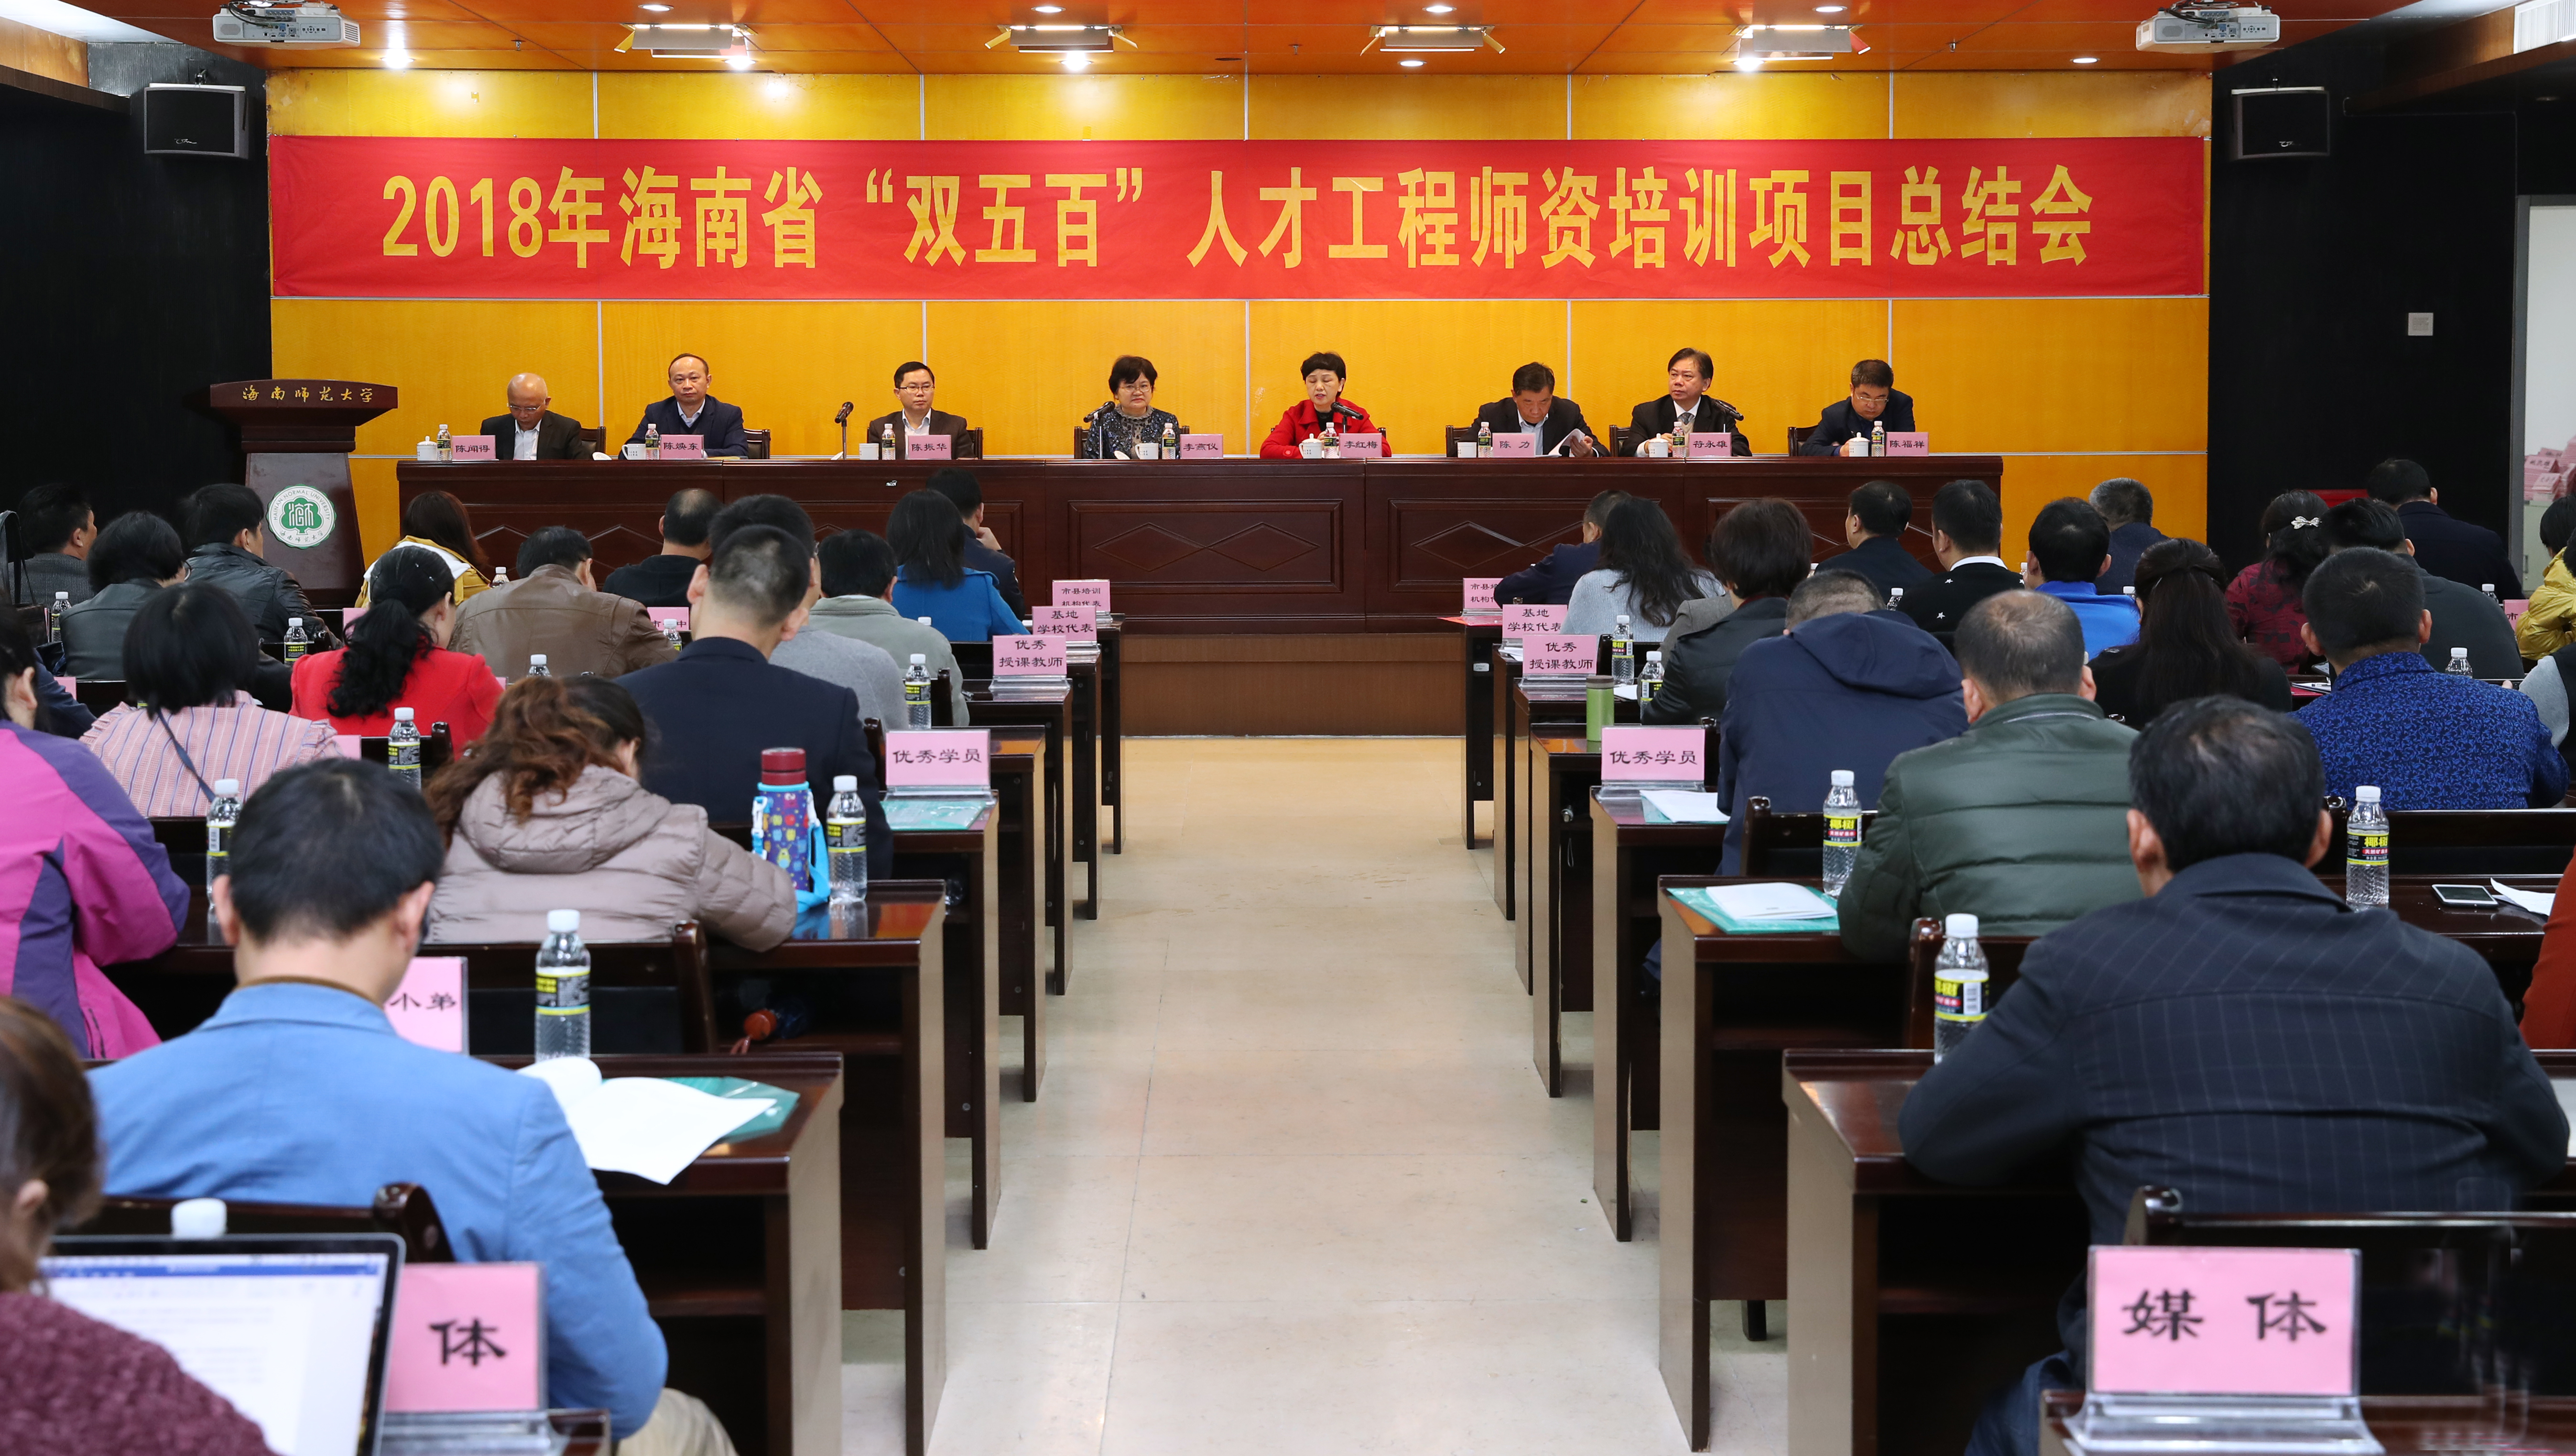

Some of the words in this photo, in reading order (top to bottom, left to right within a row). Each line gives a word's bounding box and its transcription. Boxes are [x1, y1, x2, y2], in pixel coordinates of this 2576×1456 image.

[911, 443, 947, 451] 陈振华
[1183, 443, 1218, 451] 李燕仪
[1890, 440, 1925, 449] 陈福祥
[273, 498, 283, 520] HAINAN
[283, 490, 308, 499] NORMAL
[311, 492, 330, 520] UNIVERSITY
[1051, 610, 1079, 619] 基地
[1522, 608, 1550, 617] 基地
[1037, 623, 1094, 634] 学校代表
[1507, 622, 1562, 632] 学校代表
[1015, 640, 1047, 650] 优秀
[1545, 642, 1577, 653] 优秀
[999, 657, 1063, 668] 授课教师
[1529, 659, 1594, 670] 授课教师
[892, 748, 982, 764] 优秀学员
[1609, 750, 1697, 765] 优秀学员
[1829, 819, 1854, 830] 椰树
[390, 992, 457, 1011] 小弟
[2122, 1289, 2327, 1341] 媒体
[429, 1318, 506, 1366] 体
